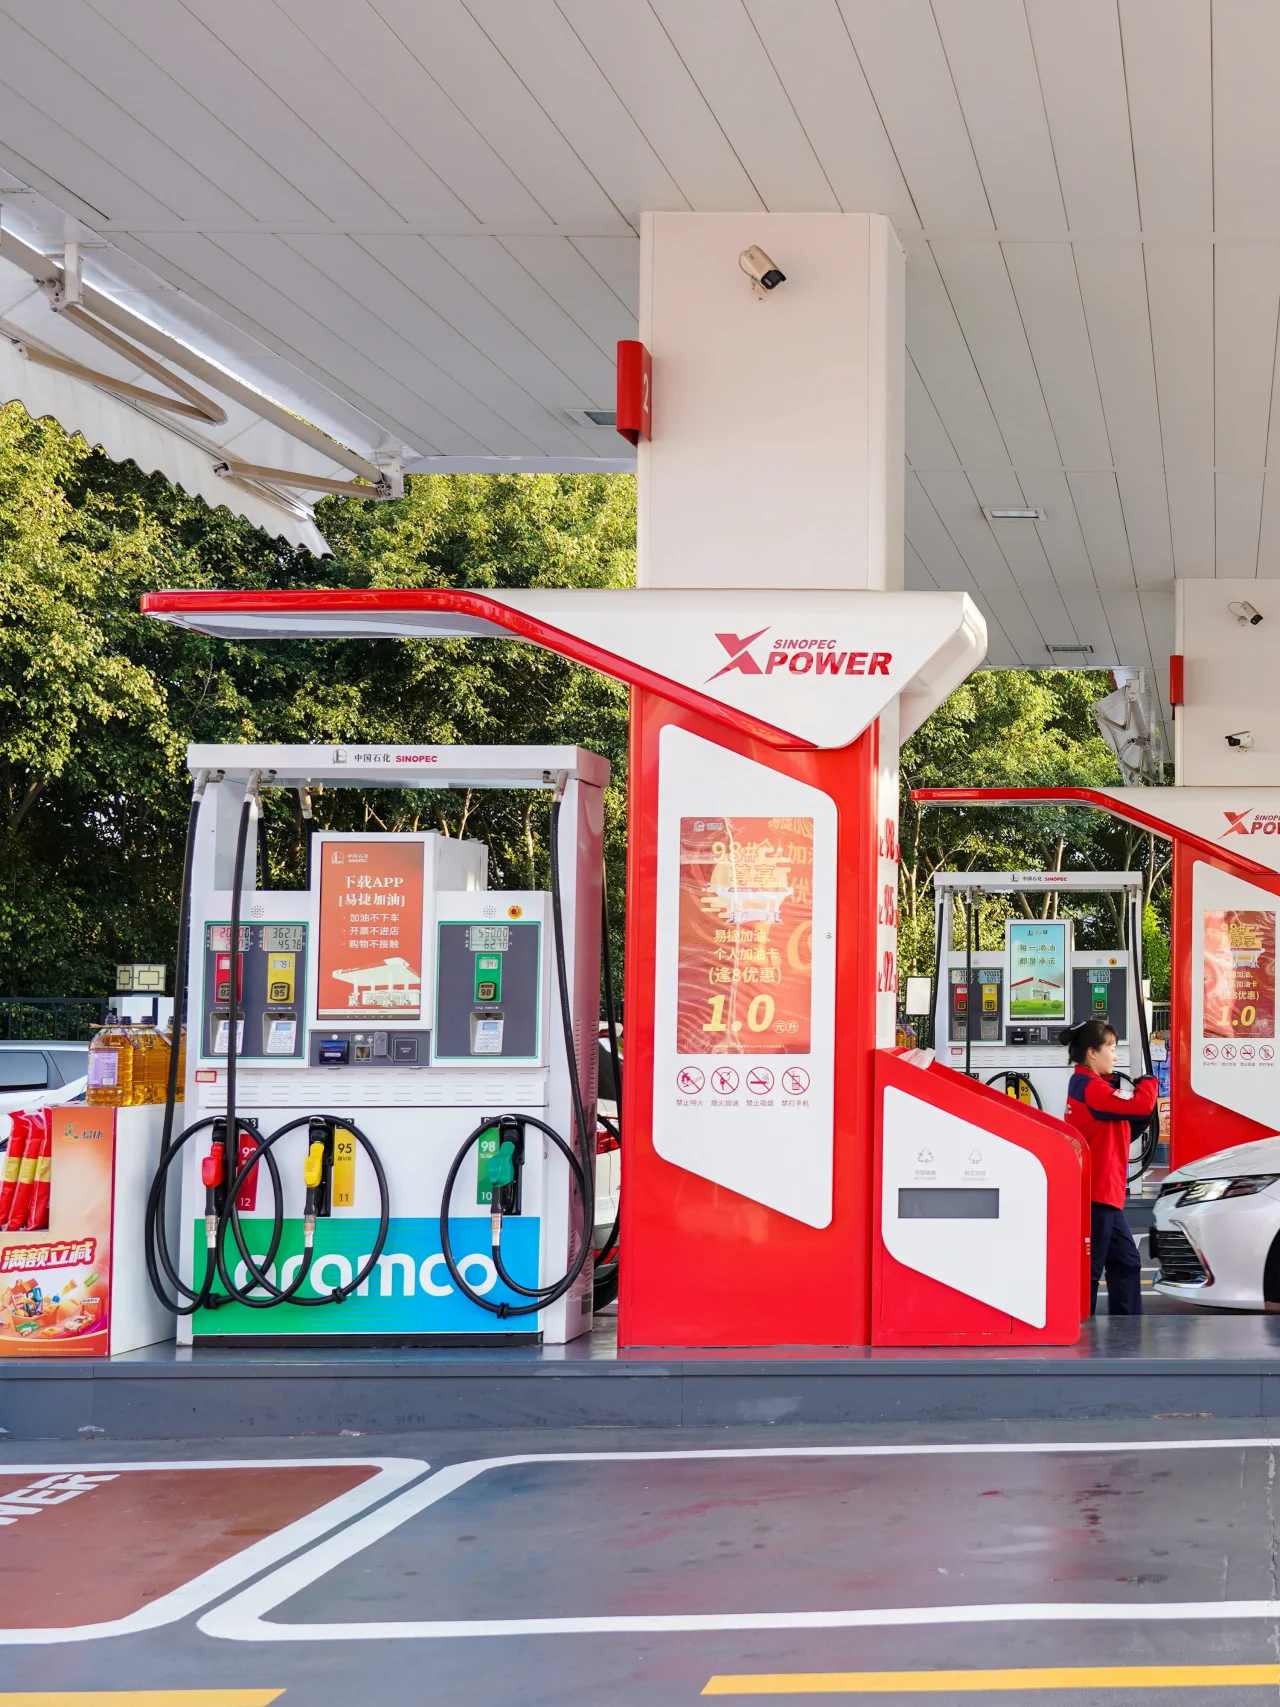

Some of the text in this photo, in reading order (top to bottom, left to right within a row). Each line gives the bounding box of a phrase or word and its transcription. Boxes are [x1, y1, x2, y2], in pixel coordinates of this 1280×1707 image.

[643, 372, 649, 414] 2
[773, 639, 837, 649] SINOPEC
[354, 754, 391, 763] 中国石化
[395, 755, 438, 763] SINOPEC
[730, 864, 775, 885] 尊享
[349, 913, 400, 922] 加油不下车
[349, 926, 400, 936] 开票不进店
[713, 948, 781, 960] 个人加油卡
[274, 989, 286, 997] 95
[480, 988, 491, 996] 98
[702, 994, 775, 1032] 1.0
[1216, 1005, 1256, 1027] 1.0
[82, 1130, 104, 1140] 易捷
[337, 1143, 353, 1154] 95
[481, 1141, 496, 1152] 98
[338, 1193, 349, 1202] 11
[481, 1191, 493, 1201] 10
[240, 1197, 251, 1207] 12
[2, 1240, 95, 1270] 满额立减
[234, 1253, 498, 1297] aramco
